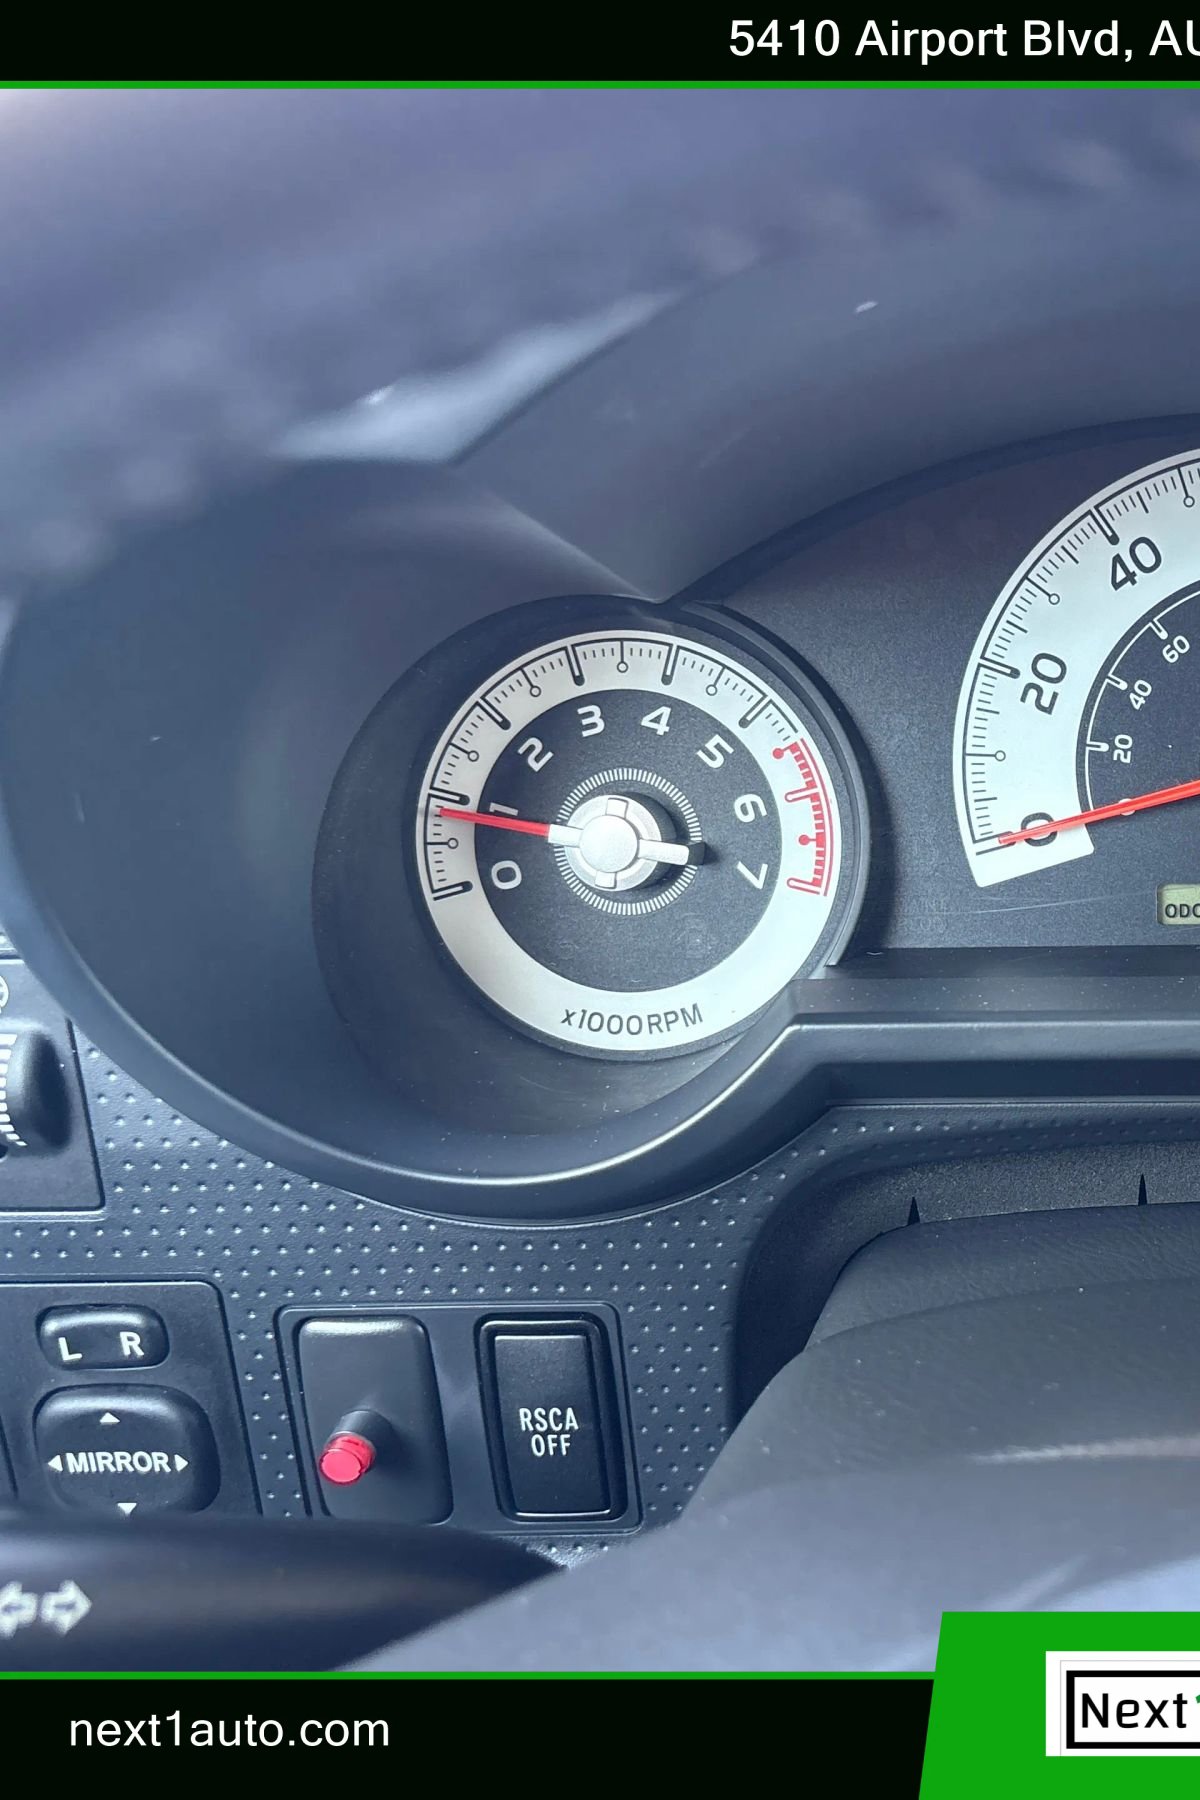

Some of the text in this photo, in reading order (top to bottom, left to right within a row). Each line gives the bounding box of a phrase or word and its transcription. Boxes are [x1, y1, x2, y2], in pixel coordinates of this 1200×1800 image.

[1108, 536, 1163, 591] 40
[1161, 634, 1191, 664] 60
[1020, 652, 1069, 716] 20
[1127, 680, 1153, 710] 40
[576, 704, 605, 737] 3
[640, 705, 672, 737] 4
[517, 737, 554, 772] 2
[696, 735, 734, 769] 5
[1114, 733, 1133, 764] 20
[490, 802, 519, 818] 1
[733, 793, 768, 823] 6
[491, 860, 522, 890] 0
[736, 861, 768, 890] 7
[58, 1331, 144, 1362] L R
[519, 1407, 579, 1432] RSCA
[531, 1433, 571, 1457] OFF
[66, 1450, 170, 1473] MIRROR
